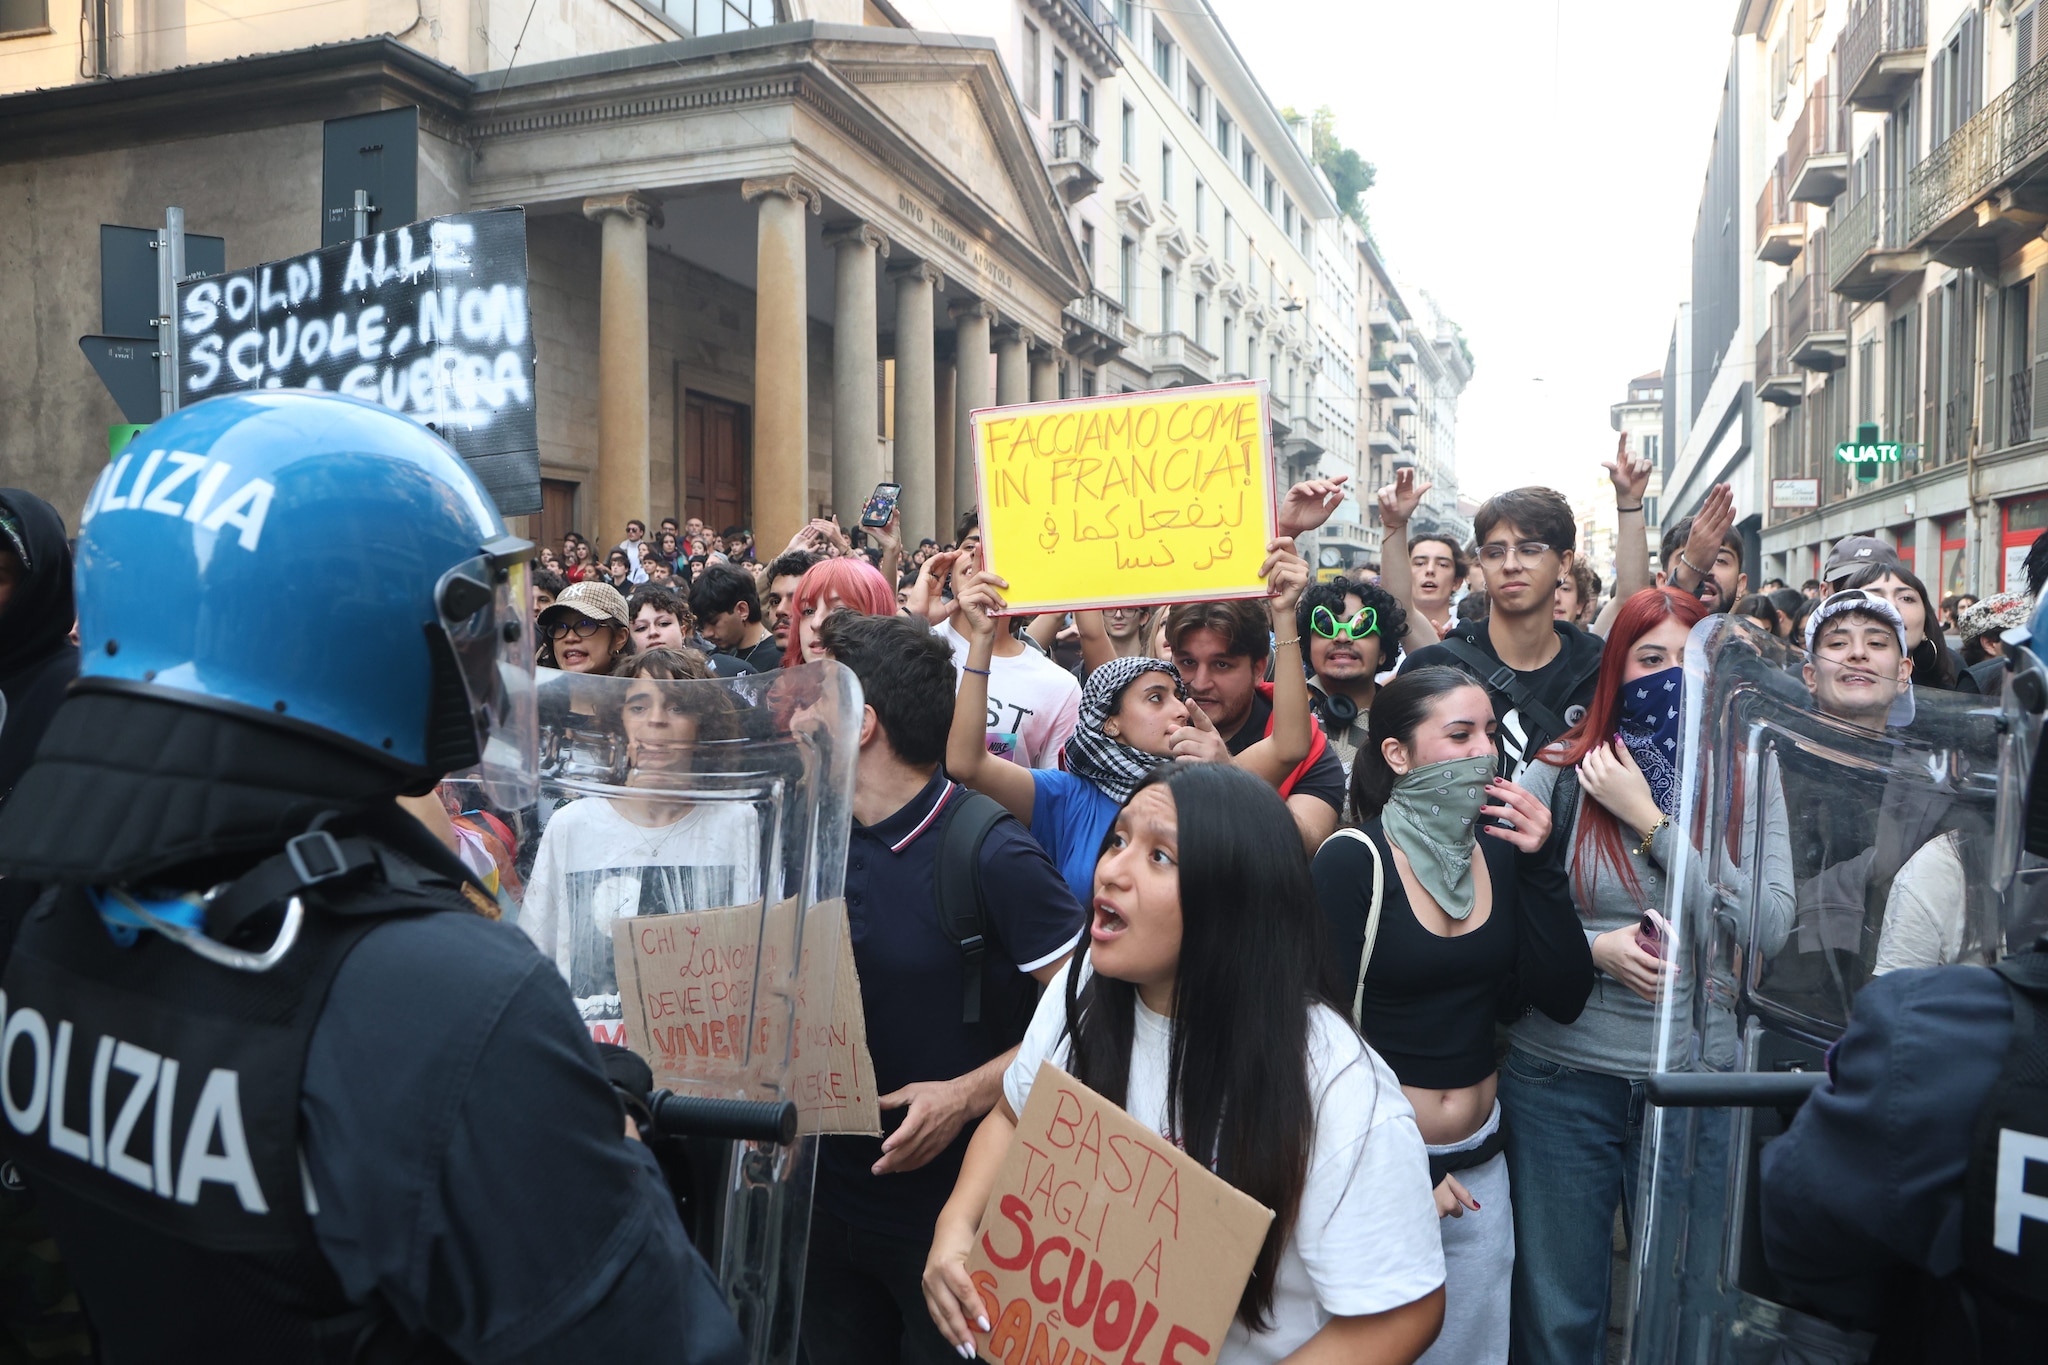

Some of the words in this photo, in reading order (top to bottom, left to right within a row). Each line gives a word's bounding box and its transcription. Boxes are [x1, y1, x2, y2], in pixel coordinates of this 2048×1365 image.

[899, 193, 923, 223] DIVO
[931, 217, 968, 256] THOMAE
[973, 250, 1012, 289] APOSTOLO
[183, 255, 321, 334] SOLDI
[342, 222, 474, 293] ALLE
[417, 286, 526, 346] NON
[986, 407, 1160, 462] FACCIAMO
[1168, 401, 1257, 443] COME
[81, 449, 275, 552] LIZIA
[994, 463, 1029, 507] IN
[1051, 441, 1253, 505] FRANCIA!
[987, 695, 1030, 735] ST
[988, 742, 1009, 752] NIKE
[641, 927, 675, 956] CHI
[648, 987, 705, 1019] DEVE
[0, 988, 269, 1215] OLIZIA
[1046, 1089, 1181, 1241] BASTA
[1022, 1141, 1110, 1252] TAGLI
[1133, 1238, 1162, 1299] A
